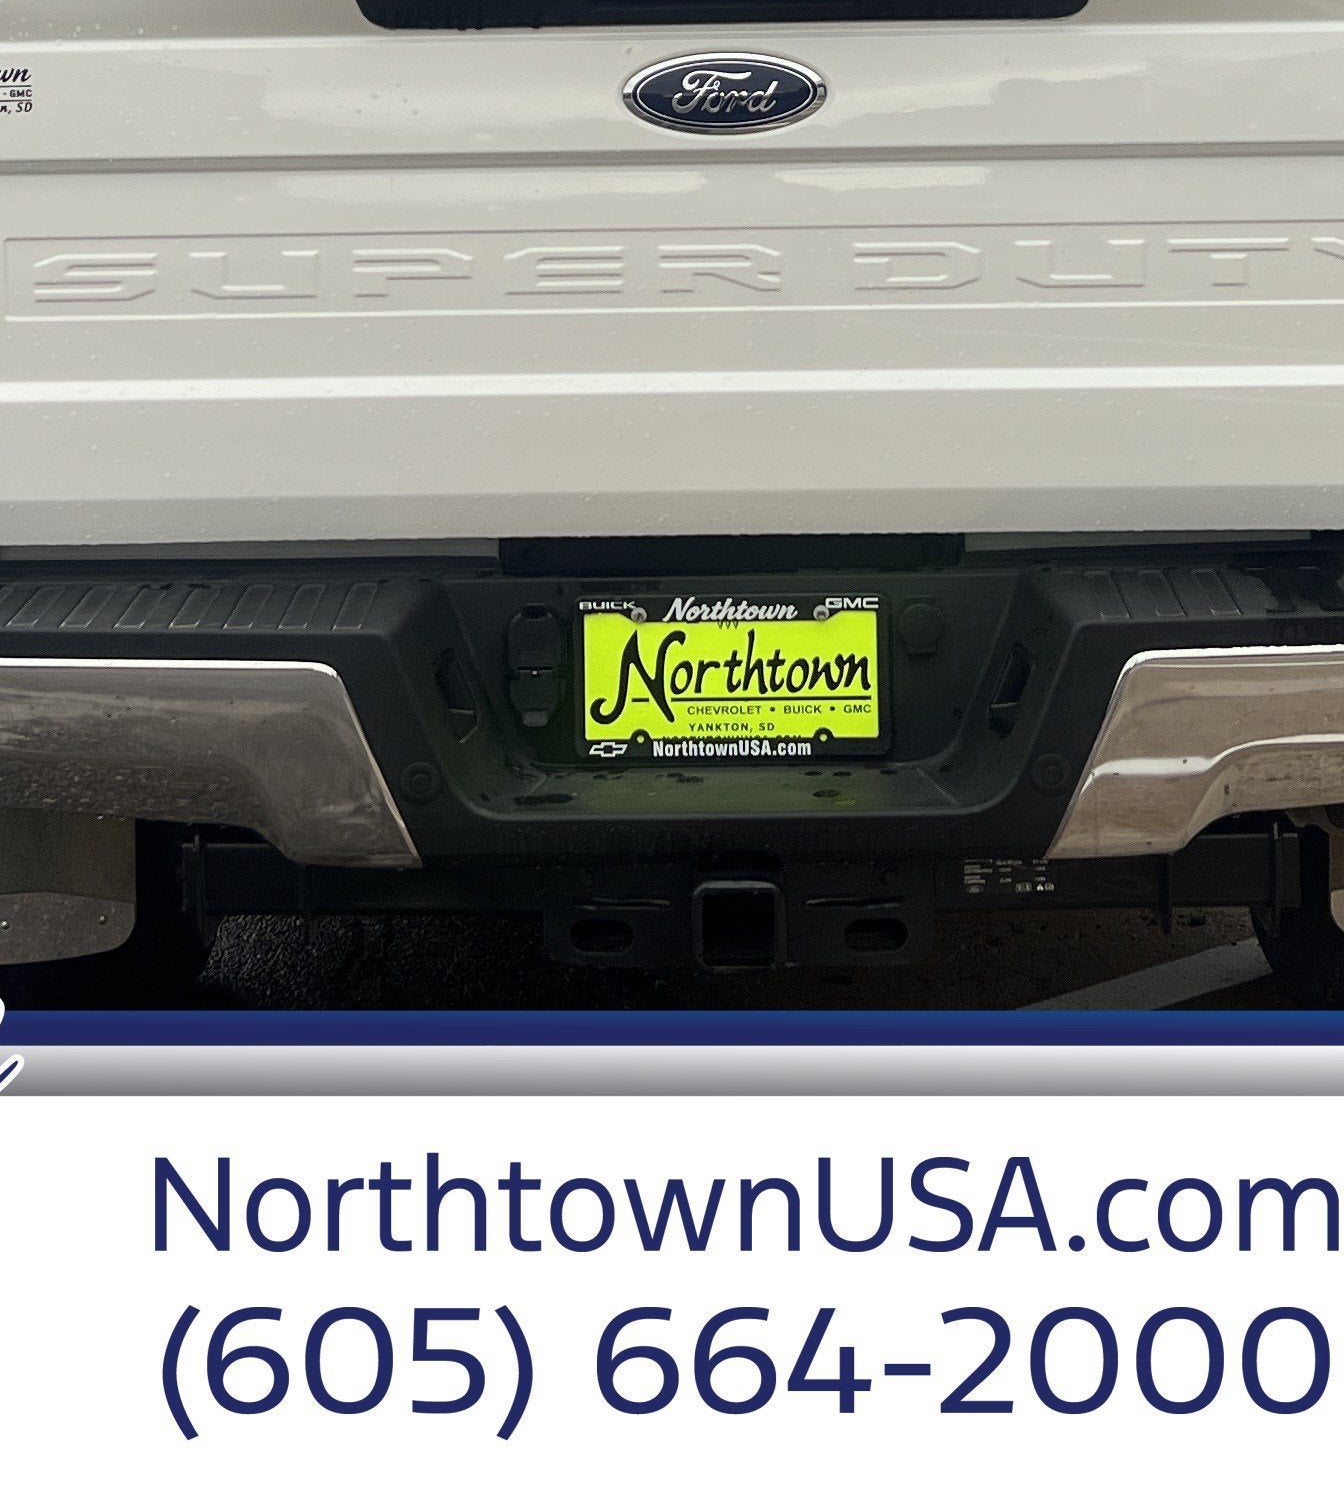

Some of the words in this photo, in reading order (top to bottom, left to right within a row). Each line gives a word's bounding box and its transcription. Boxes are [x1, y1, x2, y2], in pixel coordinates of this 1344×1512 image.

[9, 89, 33, 98] GMC
[671, 69, 779, 114] Ford
[15, 101, 33, 113] SD
[32, 244, 782, 303] SUPER
[579, 600, 637, 610] BUICK
[662, 596, 798, 622] Northtown
[825, 596, 880, 609] GMC
[589, 628, 872, 725] Northtown
[687, 704, 762, 716] CHEVROLET
[783, 704, 822, 715] BUICK
[843, 703, 872, 714] GMC
[688, 722, 754, 733] YANKTON,
[758, 722, 775, 731] SD
[652, 739, 812, 757] NorthtownUSA.com
